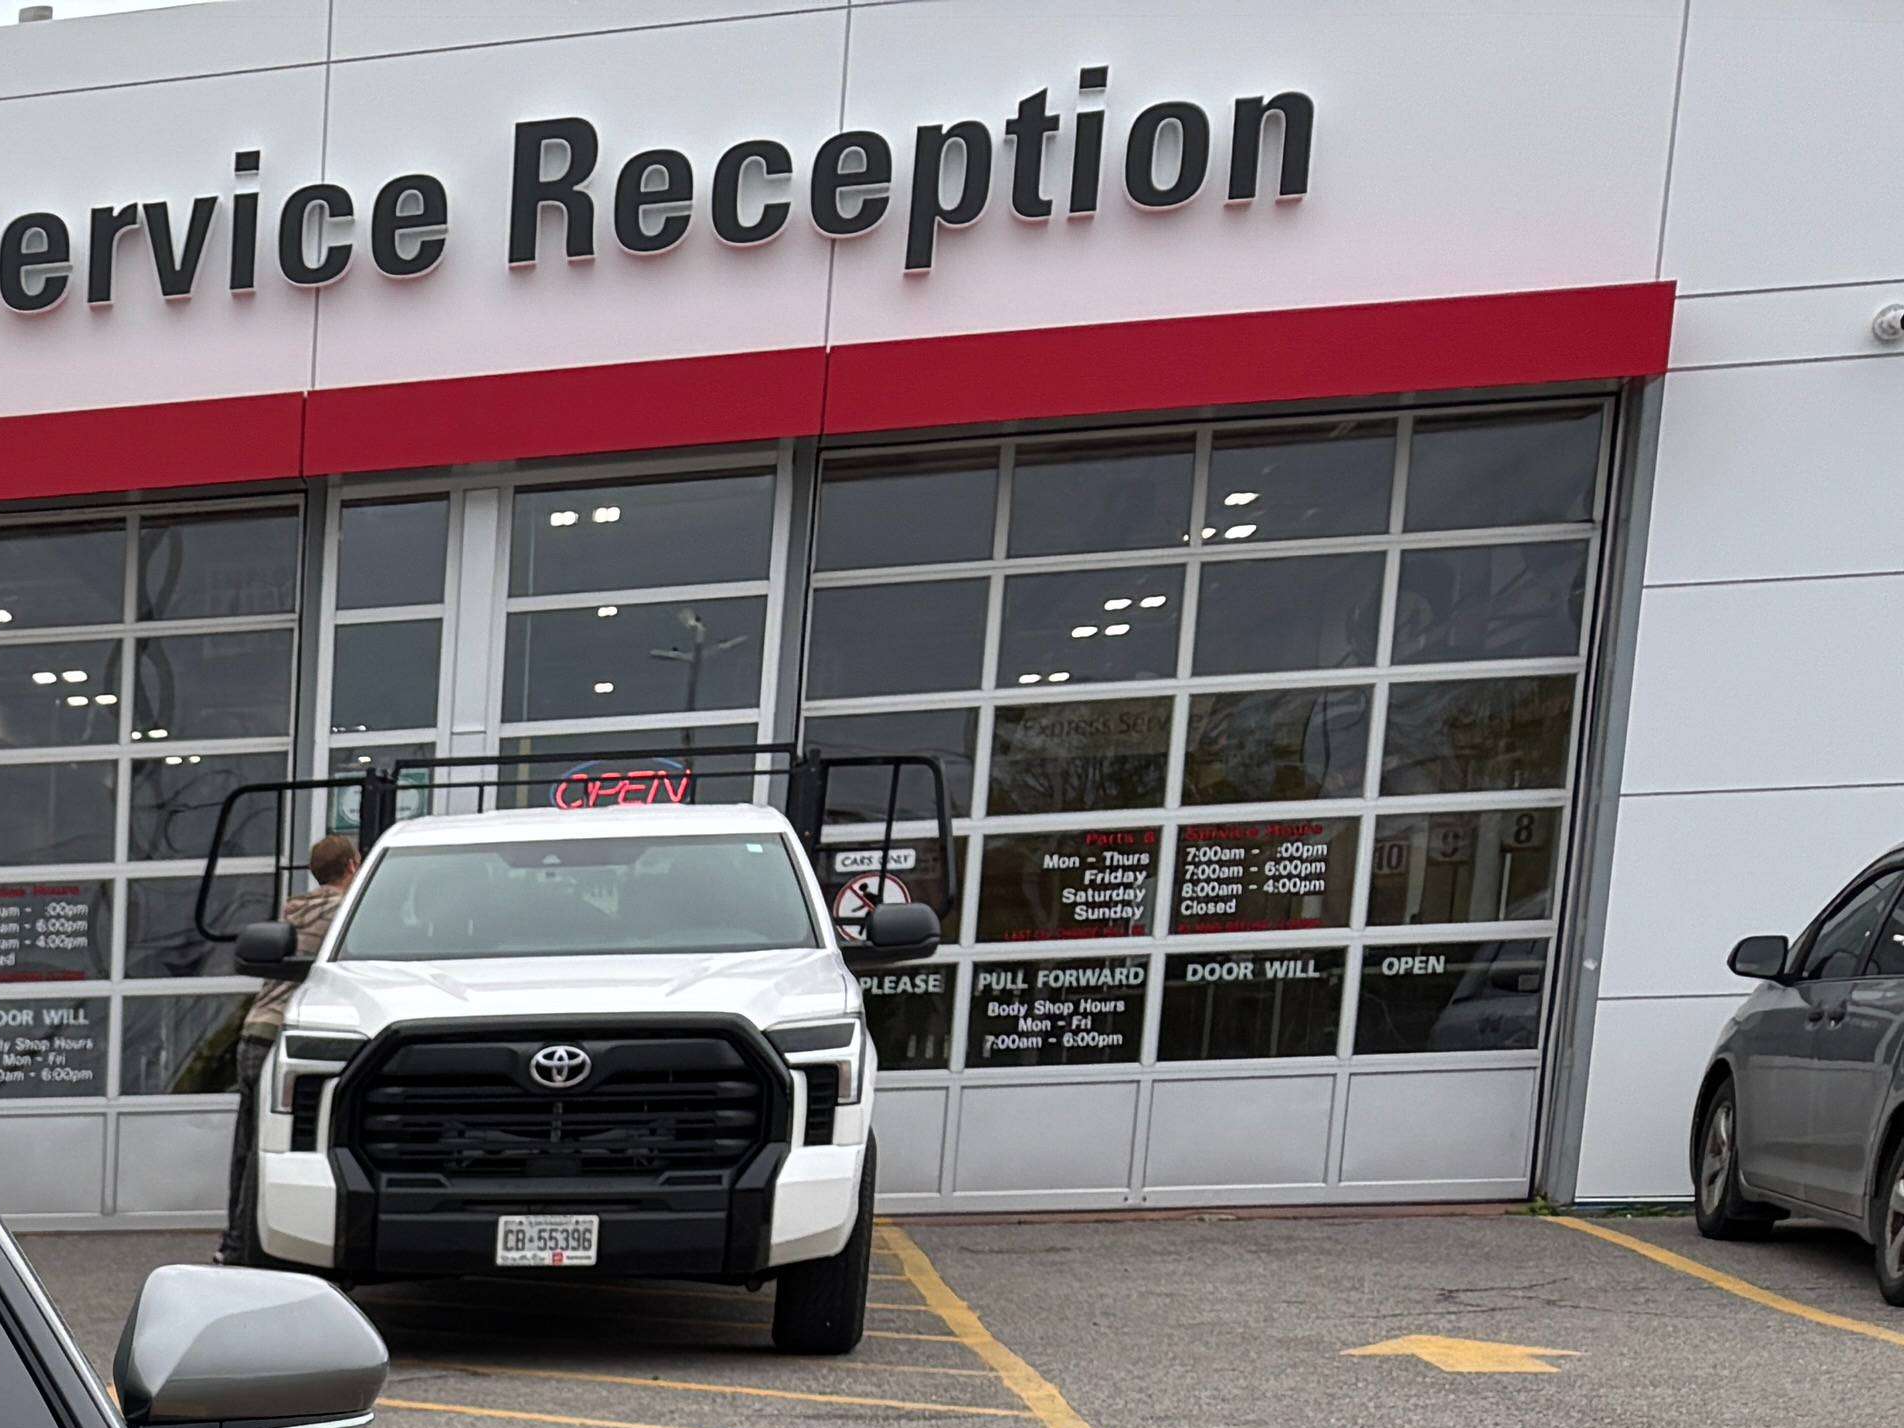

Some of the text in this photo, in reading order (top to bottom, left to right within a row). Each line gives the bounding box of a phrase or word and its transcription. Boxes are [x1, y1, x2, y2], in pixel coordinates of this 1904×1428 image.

[508, 65, 1315, 275] Reception
[555, 769, 691, 810] OPEN
[1514, 813, 1535, 844] 8
[841, 854, 909, 867] CARS NLY
[1043, 853, 1080, 869] Mon
[1103, 851, 1150, 866] Thurs
[1185, 845, 1245, 862] 7:00am
[1084, 868, 1147, 887] Friday
[1184, 864, 1243, 880] 7:00am
[1264, 860, 1326, 877] 6:00pm
[1062, 886, 1146, 904] Saturday
[1181, 882, 1243, 898] 8:00am
[1263, 878, 1325, 895] 4:00pm
[1074, 899, 1237, 920] Sunday Closed
[35, 934, 88, 949] 4:00pm
[860, 955, 1445, 994] PLEASE PULL FORWARD DOOR WILL OPEN
[42, 1008, 89, 1025] WILL
[988, 998, 1125, 1018] Body Shop Hours
[1018, 1017, 1051, 1032] Mon
[1072, 1015, 1092, 1030] Fri
[15, 1037, 50, 1051] Shop
[54, 1037, 94, 1050] Hours
[983, 1035, 1042, 1050] 7:00am
[1063, 1033, 1123, 1049] 6:00pm
[3, 1053, 32, 1066] Mon
[48, 1053, 66, 1066] Fri
